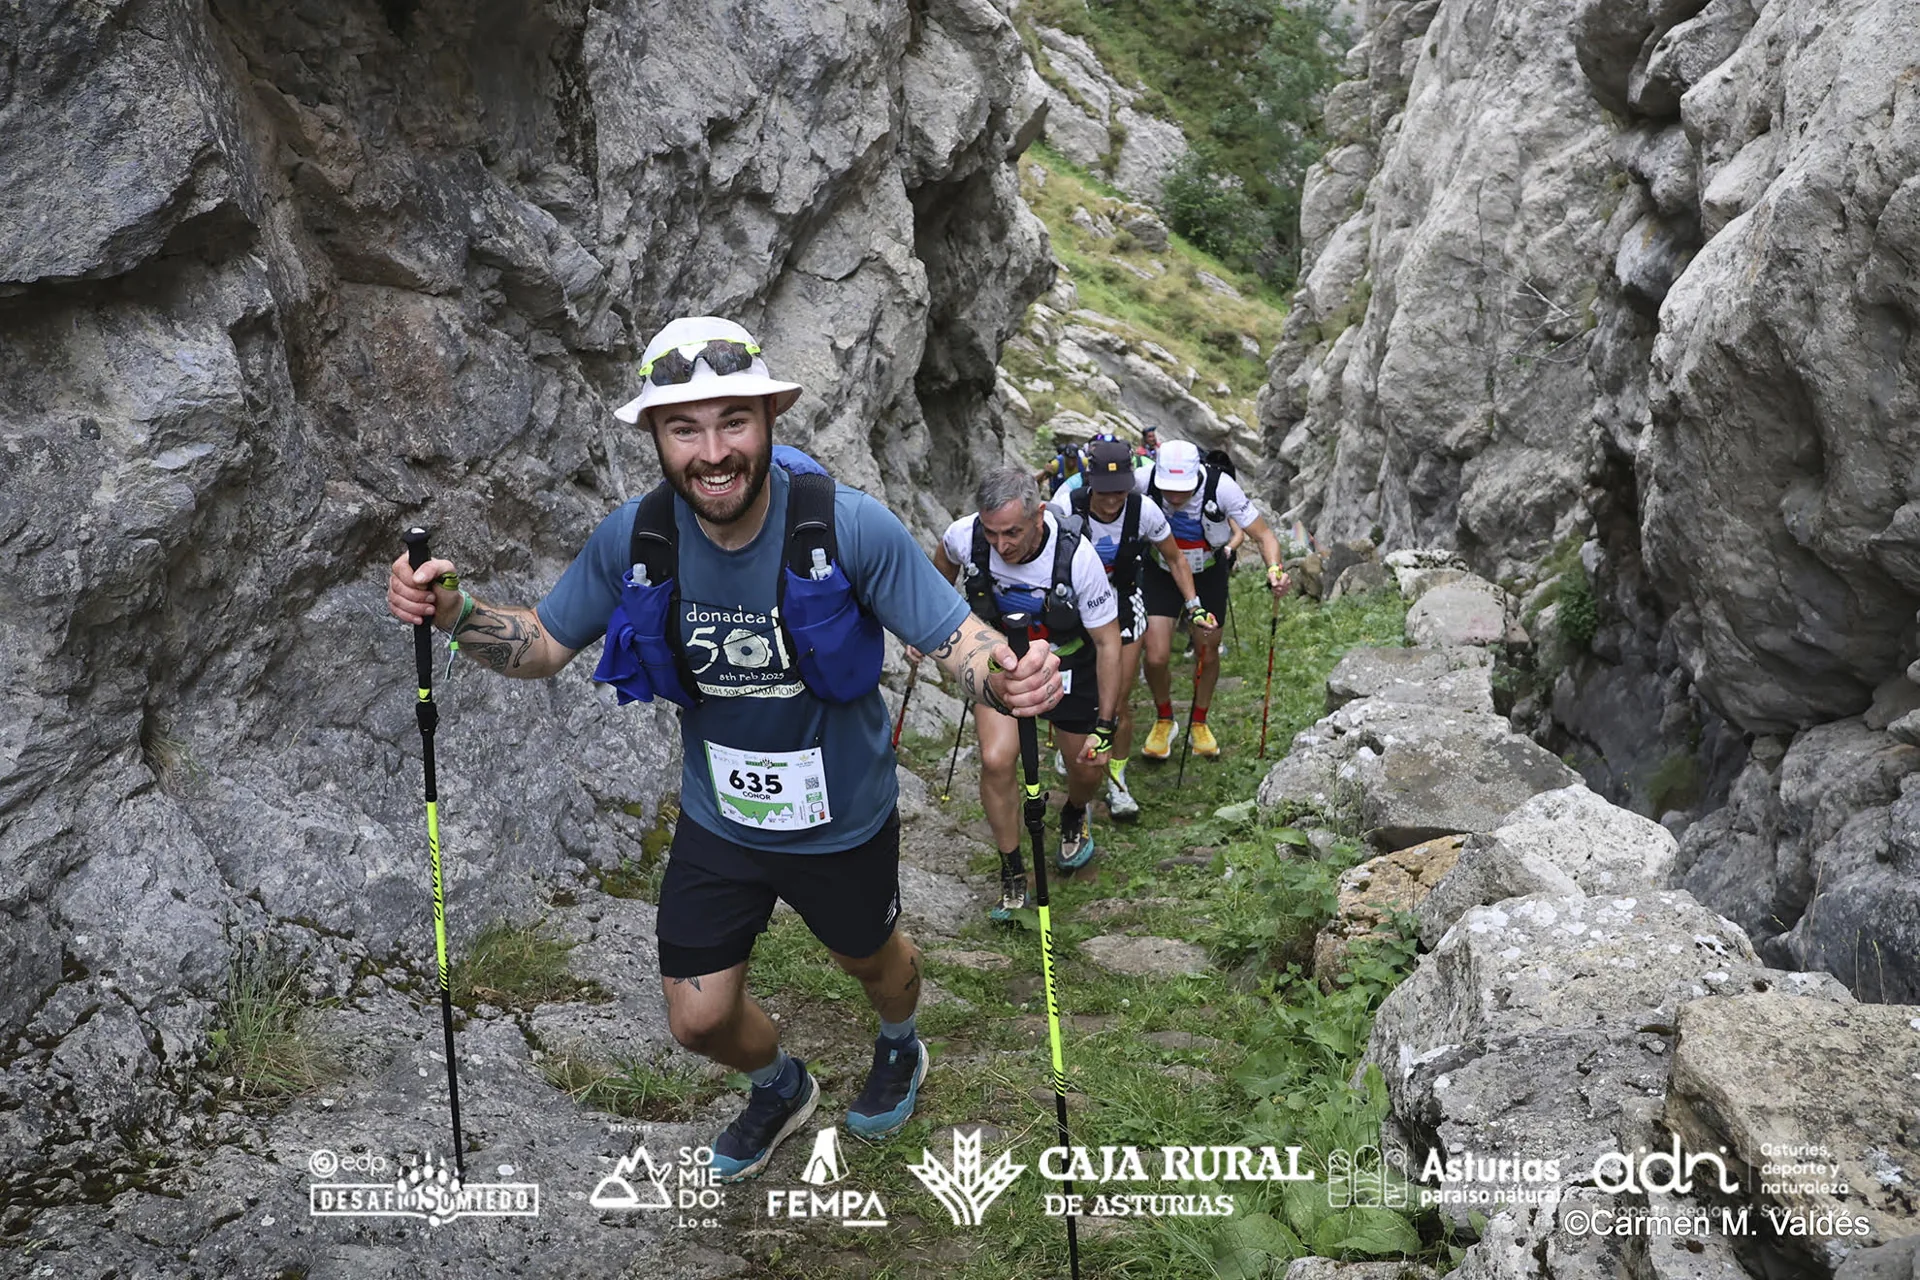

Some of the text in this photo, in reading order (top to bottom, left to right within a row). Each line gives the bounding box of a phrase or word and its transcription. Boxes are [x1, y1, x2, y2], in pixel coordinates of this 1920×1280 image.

[719, 672, 737, 681] 8th
[761, 672, 784, 681] 2025
[728, 769, 783, 795] 635
[742, 790, 771, 801] CONOR
